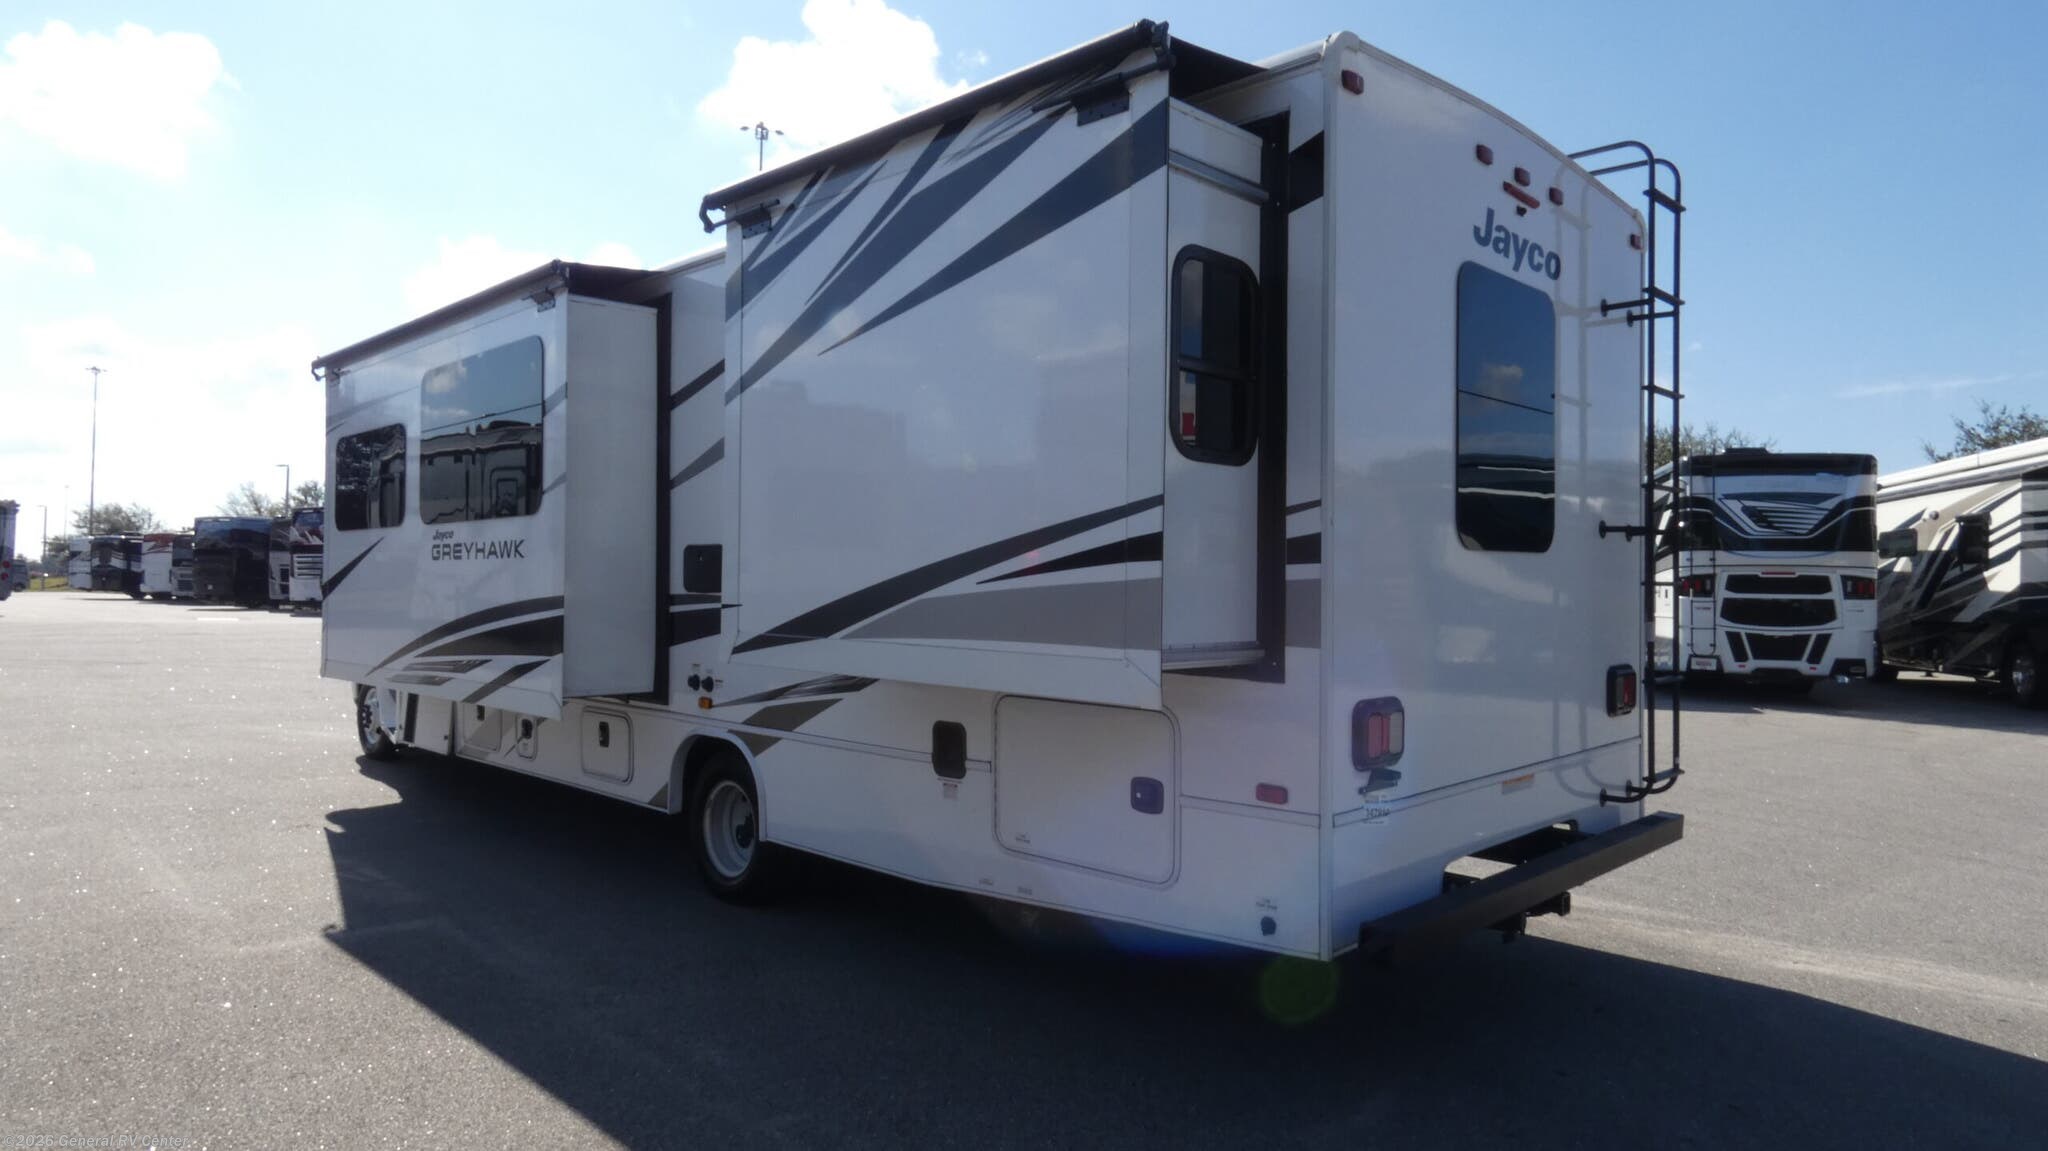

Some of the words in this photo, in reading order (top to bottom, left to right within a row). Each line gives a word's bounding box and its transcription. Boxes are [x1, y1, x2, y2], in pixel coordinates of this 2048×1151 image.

[1473, 207, 1561, 280] Jayco
[432, 530, 454, 541] Jayco
[432, 539, 525, 560] GREYHAWK
